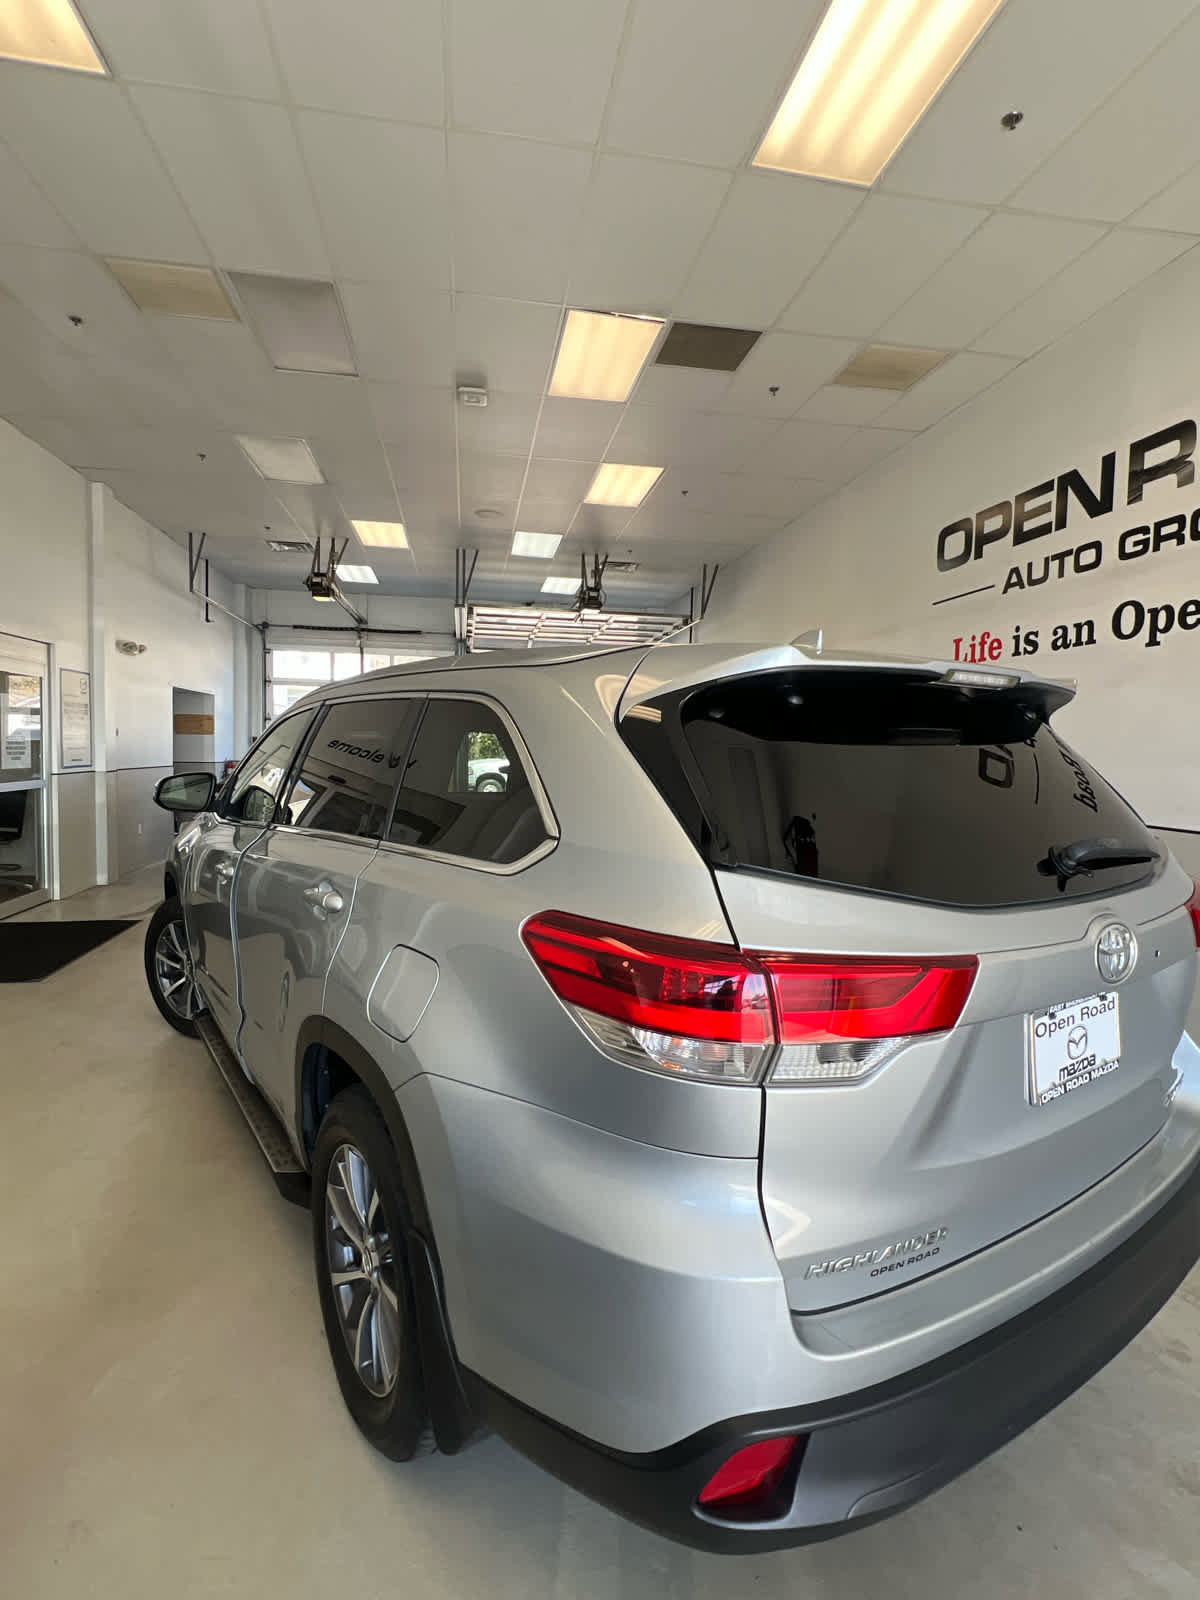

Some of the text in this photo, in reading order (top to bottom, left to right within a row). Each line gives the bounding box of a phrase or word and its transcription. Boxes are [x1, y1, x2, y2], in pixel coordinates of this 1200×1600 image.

[937, 451, 1116, 573] OPEN
[1002, 540, 1102, 595] AUTO
[953, 631, 1003, 664] Life
[1011, 625, 1039, 657] is
[1051, 618, 1097, 651] an
[1035, 1014, 1075, 1038] Open
[1080, 997, 1115, 1021] Road
[1041, 1060, 1120, 1104] OPEN ROAD MAZDA
[1058, 1054, 1097, 1082] mazda
[803, 1225, 949, 1280] HIGHLANDER
[870, 1247, 940, 1277] OPEN ROAD
